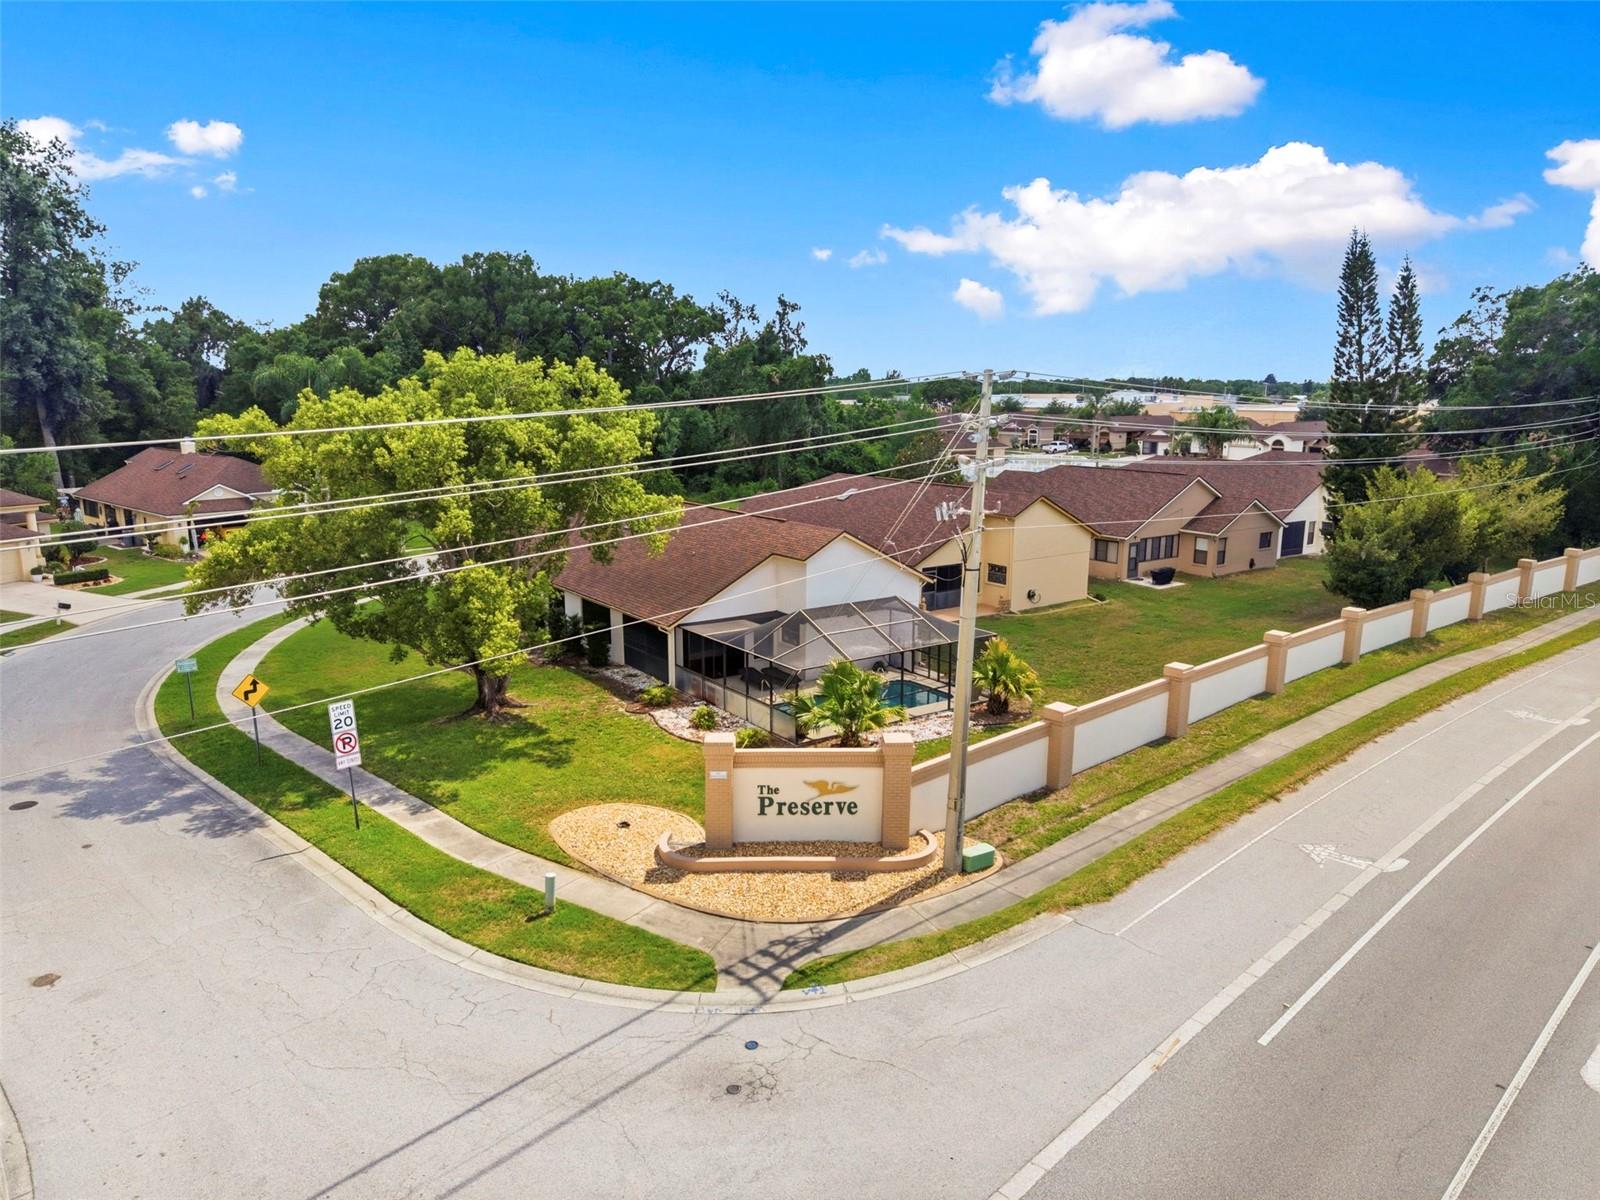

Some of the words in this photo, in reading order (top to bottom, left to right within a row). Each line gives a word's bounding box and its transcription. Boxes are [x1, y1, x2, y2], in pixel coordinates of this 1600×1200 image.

[331, 703, 352, 713] SPEED
[334, 709, 350, 718] LIMIT
[333, 715, 354, 730] 20
[757, 785, 780, 795] The
[757, 796, 858, 816] Preserve
